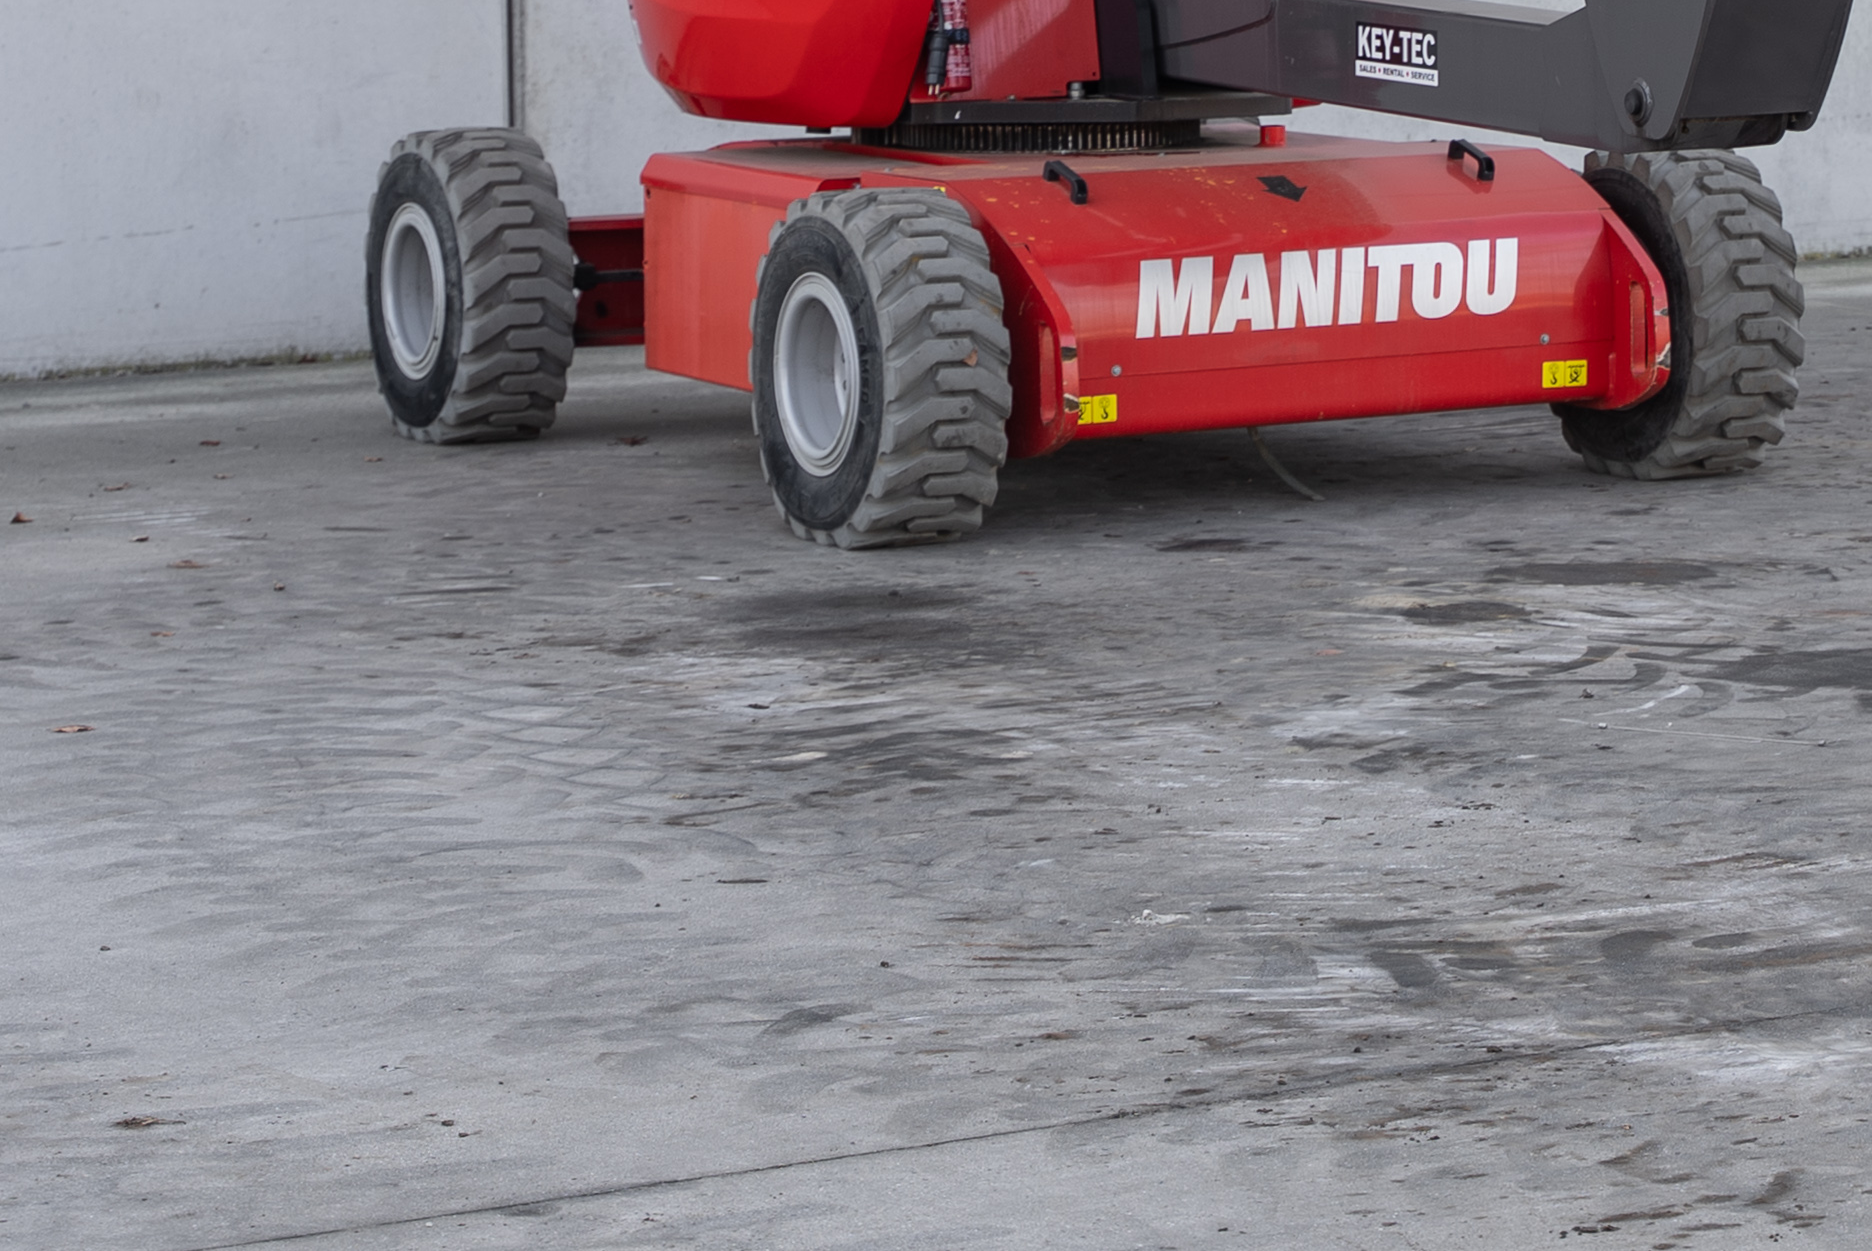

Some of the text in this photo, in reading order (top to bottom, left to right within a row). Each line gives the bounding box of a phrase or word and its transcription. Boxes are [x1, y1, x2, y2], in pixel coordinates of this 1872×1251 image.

[1358, 25, 1436, 67] KEY-TEC
[1359, 64, 1435, 82] SALES RENTAL SERVICE
[1135, 237, 1519, 339] MANITOU
